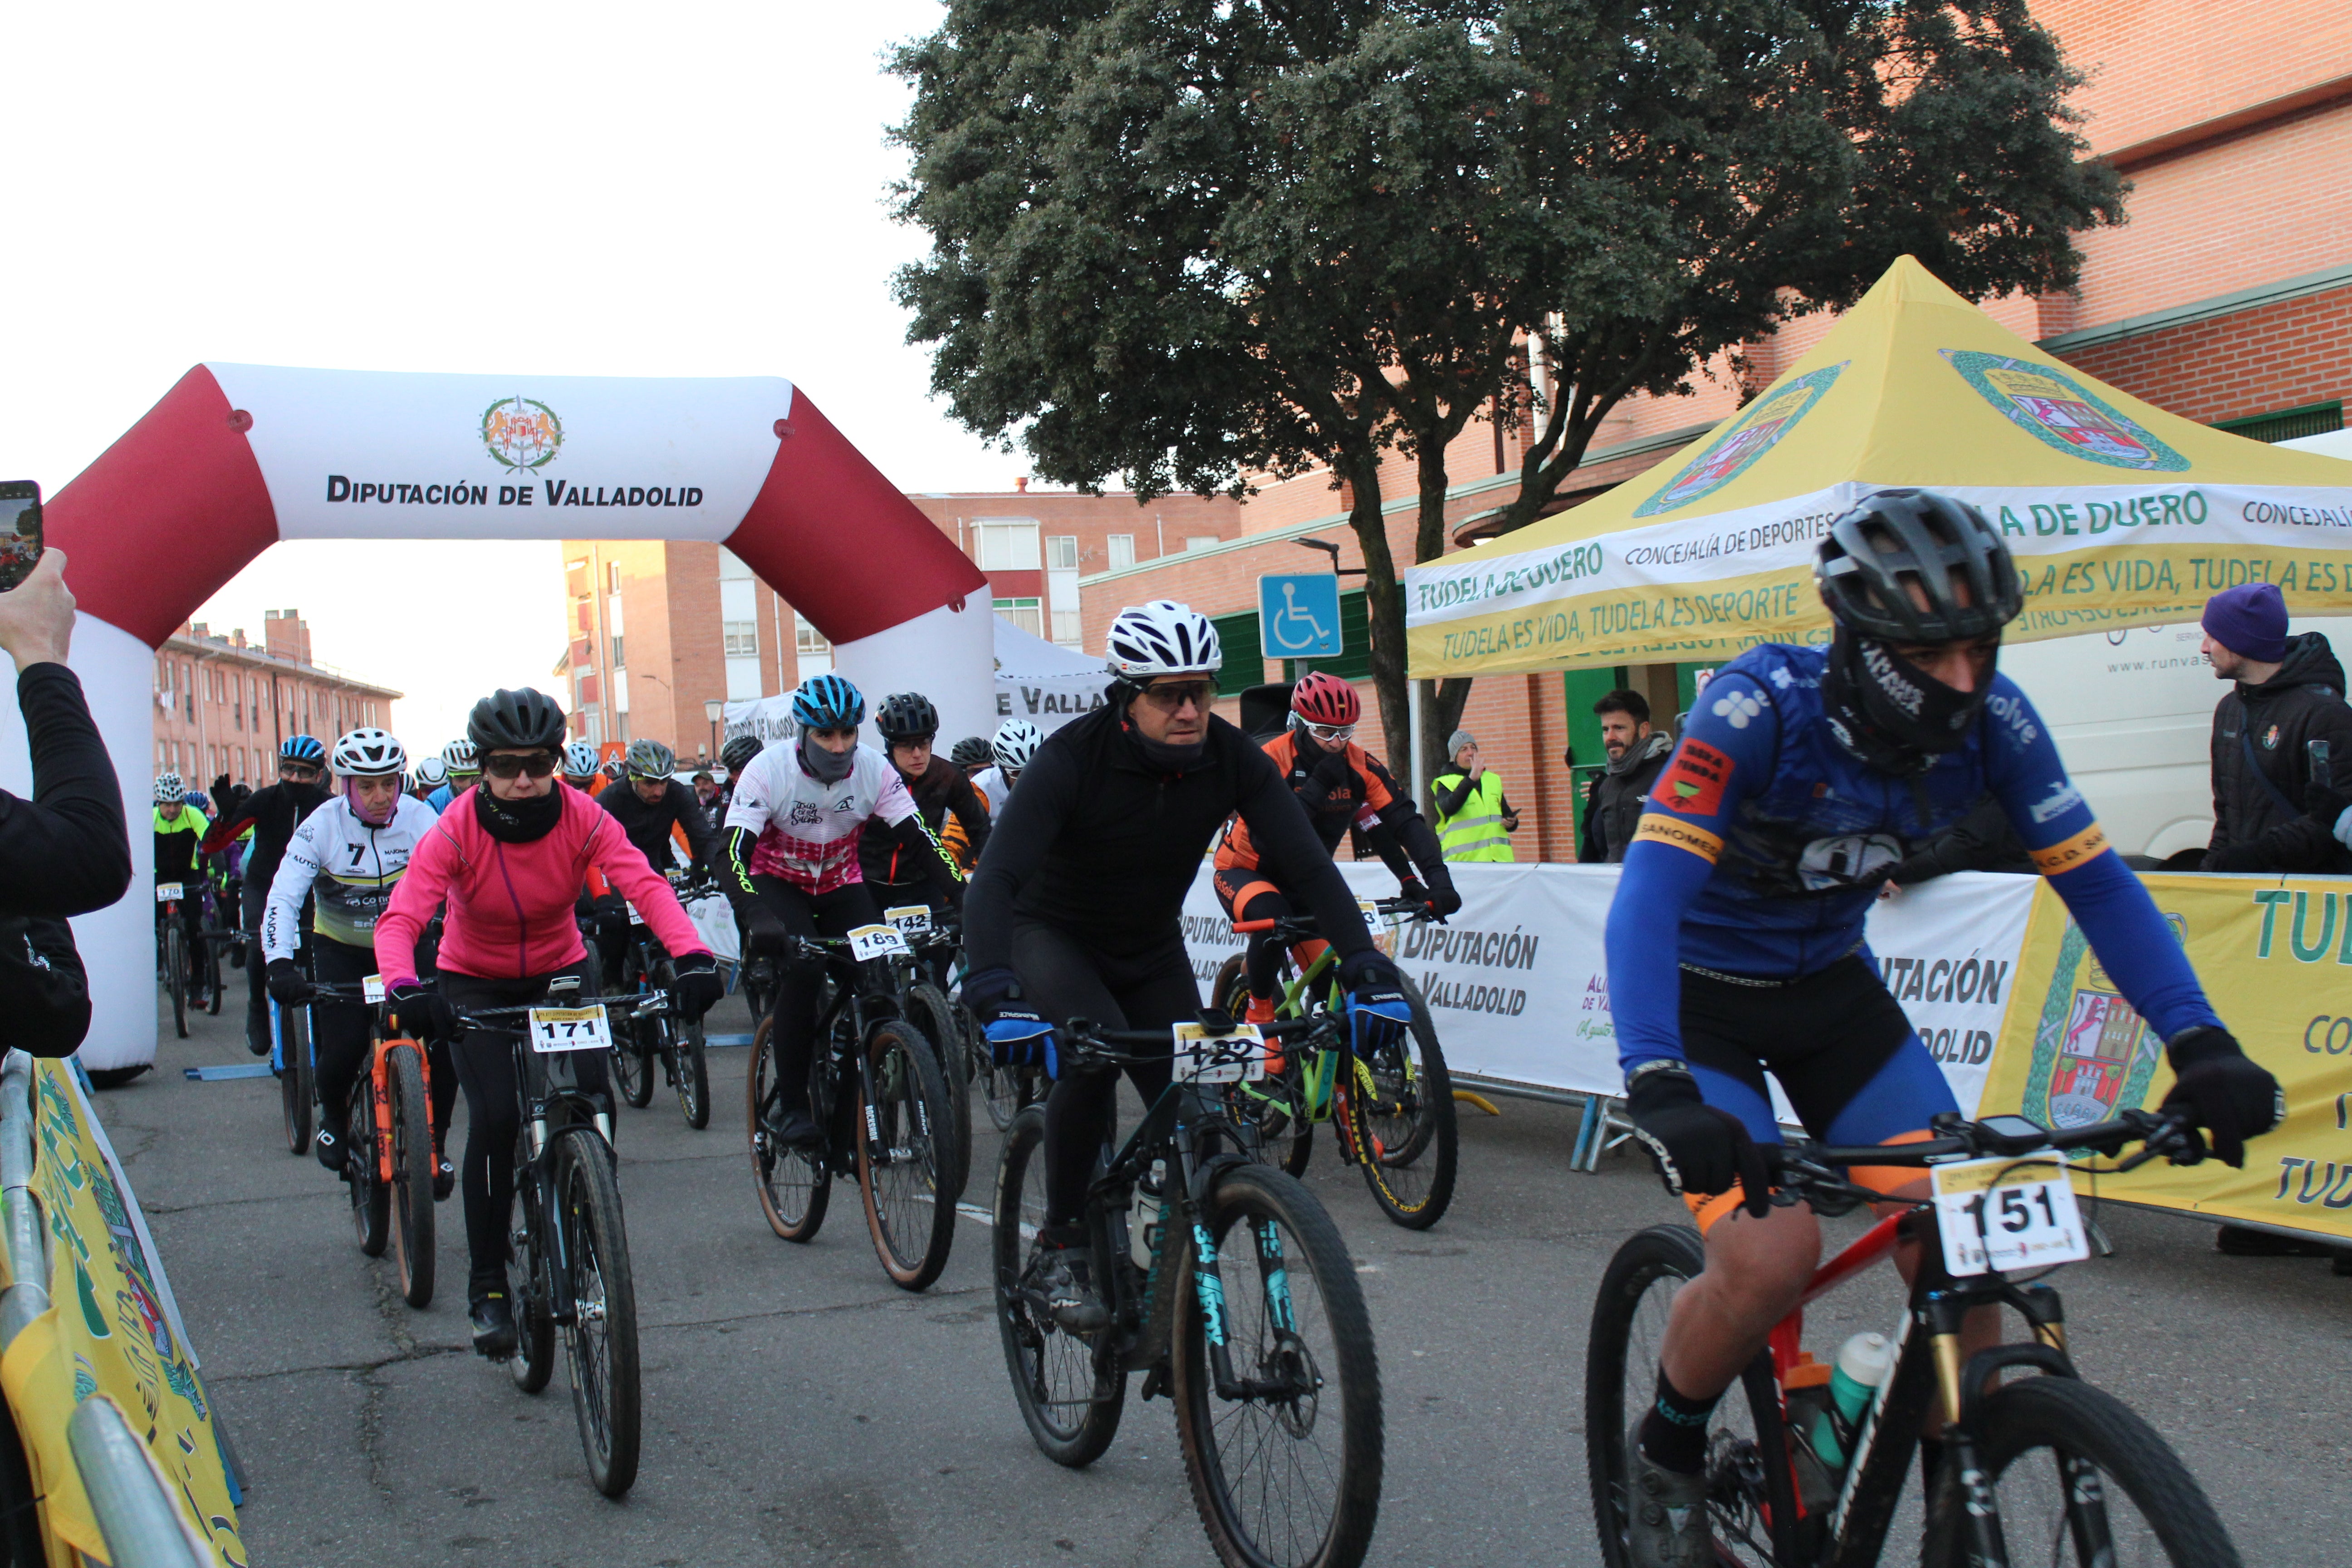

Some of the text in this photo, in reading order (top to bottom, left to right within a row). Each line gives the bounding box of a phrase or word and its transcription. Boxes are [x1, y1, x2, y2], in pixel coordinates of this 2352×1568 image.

[327, 475, 703, 507] DIPUTACIÓN DE VALLADOLID
[2029, 503, 2080, 536] DE
[2086, 490, 2208, 534] DUERO
[2242, 500, 2352, 528] CONCEJALÍ
[1625, 512, 1834, 565] CONCEJALÍA DE DEPORTES
[1418, 573, 1494, 612] TUDELA
[2062, 561, 2095, 594] ES
[2103, 559, 2180, 595] VIDA,
[2306, 562, 2337, 593] ES
[1443, 583, 1799, 660] TUDELA ES VIDA, TUDELA ES DEPORTE
[995, 686, 1104, 716] E VALLA
[294, 855, 318, 869] AUTO
[893, 914, 926, 931] 142
[1363, 911, 1375, 924] 3
[860, 933, 899, 948] 189
[1403, 919, 1539, 970] DIPUTACIÓN
[1421, 971, 1526, 1016] VALLADOLID
[542, 1020, 596, 1039] 171
[2304, 1014, 2352, 1056] CO
[1189, 1038, 1254, 1066] 122
[1964, 1185, 2057, 1238] 151
